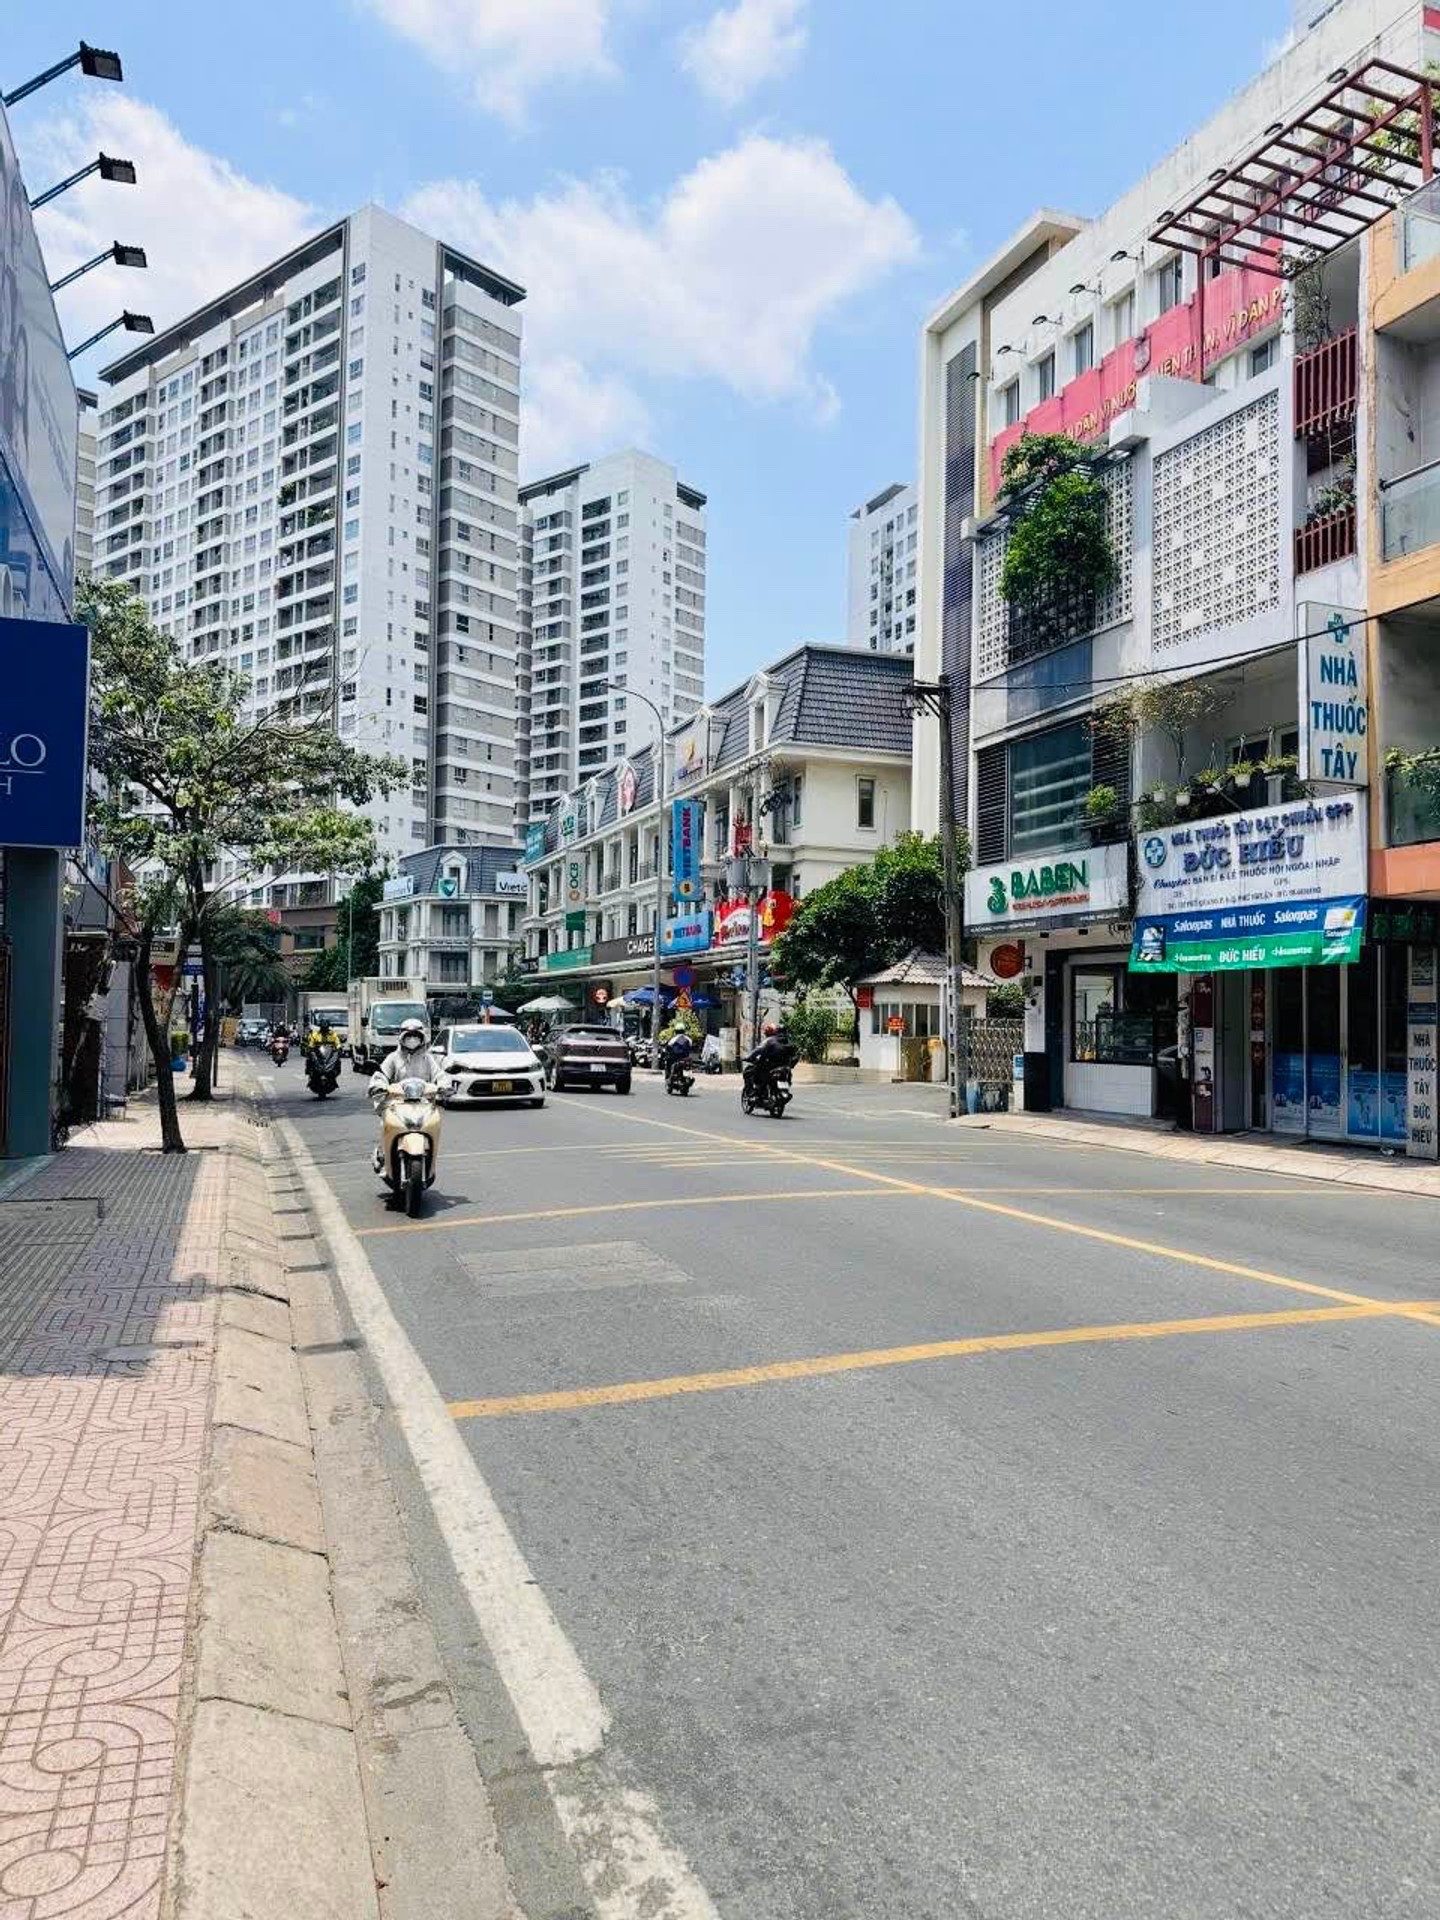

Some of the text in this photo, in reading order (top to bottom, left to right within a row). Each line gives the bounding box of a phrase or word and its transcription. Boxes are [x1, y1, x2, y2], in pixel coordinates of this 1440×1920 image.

[1237, 295, 1269, 330] DÂN
[1320, 651, 1357, 687] NHÀ
[1311, 695, 1366, 736] THUỐC
[1321, 742, 1357, 780] TÂY
[1195, 819, 1230, 842] THUỐC
[1326, 802, 1354, 819] GPP
[680, 806, 692, 879] VIETBANK
[1183, 828, 1304, 873] ĐỨC HIẾU
[569, 862, 579, 889] OCB
[1011, 859, 1089, 899] BABEN
[1239, 864, 1267, 878] THUỐC
[1173, 909, 1318, 934] Salonpas NHÀ THUỐC Salonpas
[1219, 947, 1240, 964] ĐỨC
[1241, 944, 1266, 962] HIẾU
[1414, 1031, 1431, 1048] NHÀ
[1408, 1052, 1436, 1072] THUỐC
[1413, 1077, 1430, 1095] TÂY
[1413, 1102, 1431, 1119] ĐỨC
[1411, 1126, 1433, 1144] HIẾU
